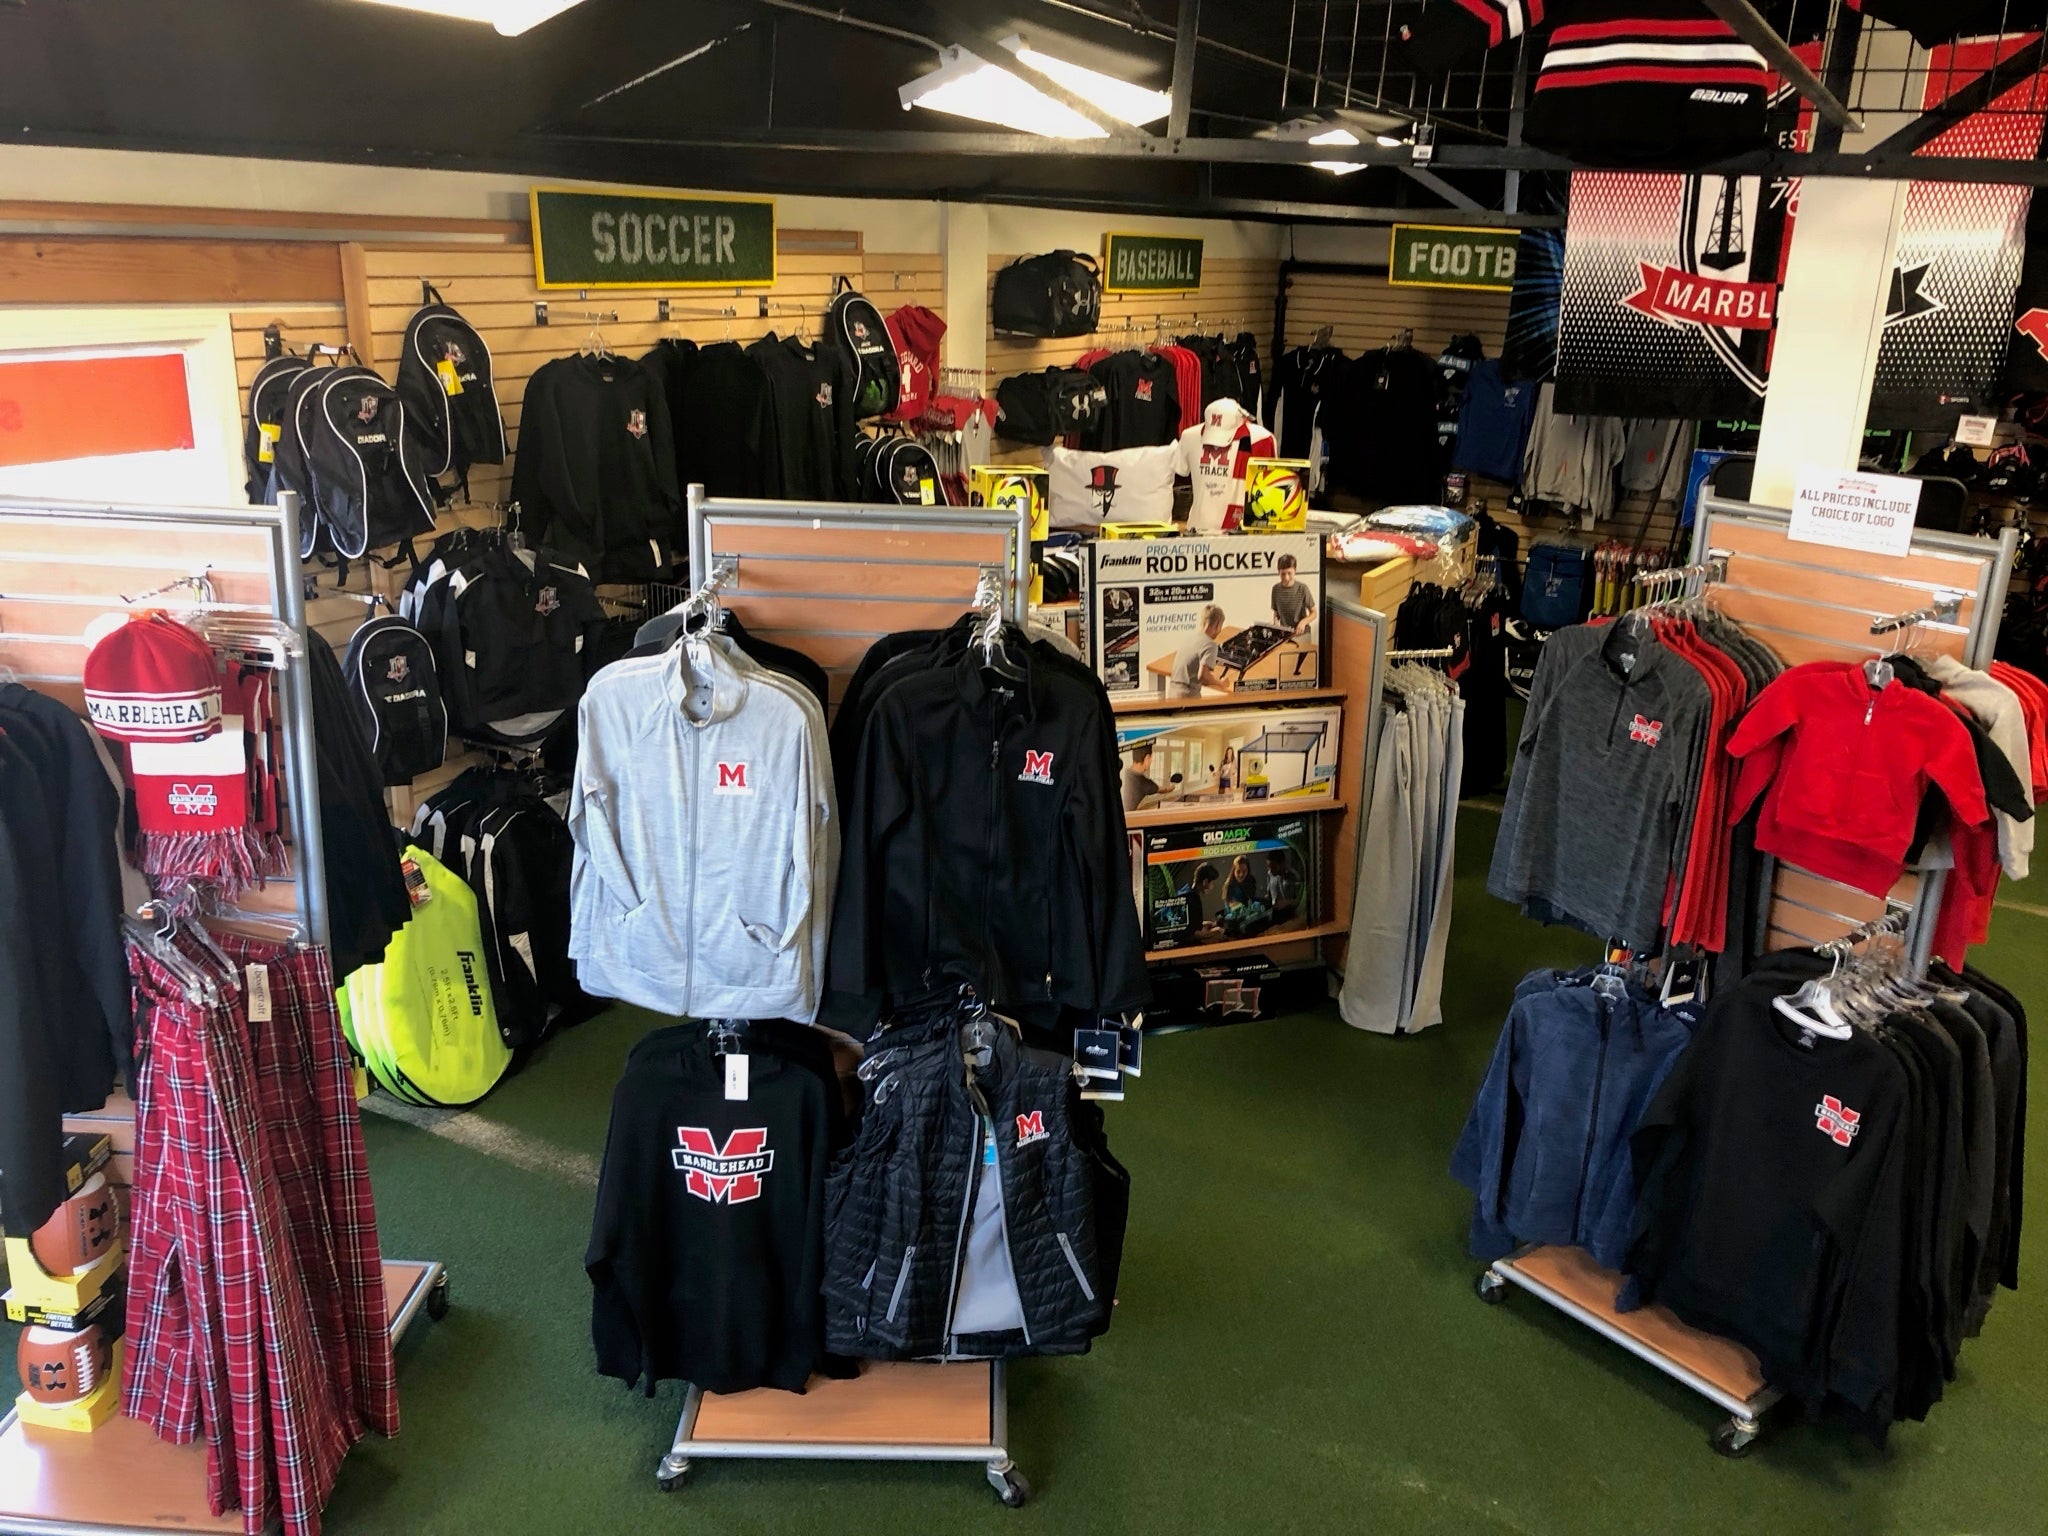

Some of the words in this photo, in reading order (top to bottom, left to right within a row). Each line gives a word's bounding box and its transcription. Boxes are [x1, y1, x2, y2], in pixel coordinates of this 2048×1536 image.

[1690, 88, 1749, 105] BAUER
[591, 210, 736, 265] SOCCER
[1116, 247, 1194, 283] BASEBALL
[1409, 241, 1517, 279] FOOTB
[1664, 279, 1772, 319] MARBL
[1200, 444, 1230, 466] M
[1199, 465, 1230, 478] TRACK
[1800, 489, 1820, 502] ALL
[1822, 491, 1861, 507] PRICES
[1862, 497, 1912, 514] INCLUDE
[1811, 506, 1850, 522] CHOICE
[1851, 512, 1865, 523] OF
[1867, 514, 1895, 528] LOGO
[1146, 555, 1188, 574] ROD
[1194, 551, 1276, 572] HOCKEY
[1146, 613, 1198, 625] AUTHENTIC
[89, 701, 209, 725] MARBLEHEAD
[717, 763, 747, 787] M
[1023, 749, 1054, 778] M
[1203, 827, 1252, 844] GLOMAX
[1203, 847, 1221, 856] ROD
[1222, 844, 1250, 854] HOCKEY
[456, 951, 483, 1016] franklin
[1016, 1110, 1045, 1140] M
[677, 1126, 768, 1205] M
[682, 1154, 765, 1174] MARBLEHEAD
